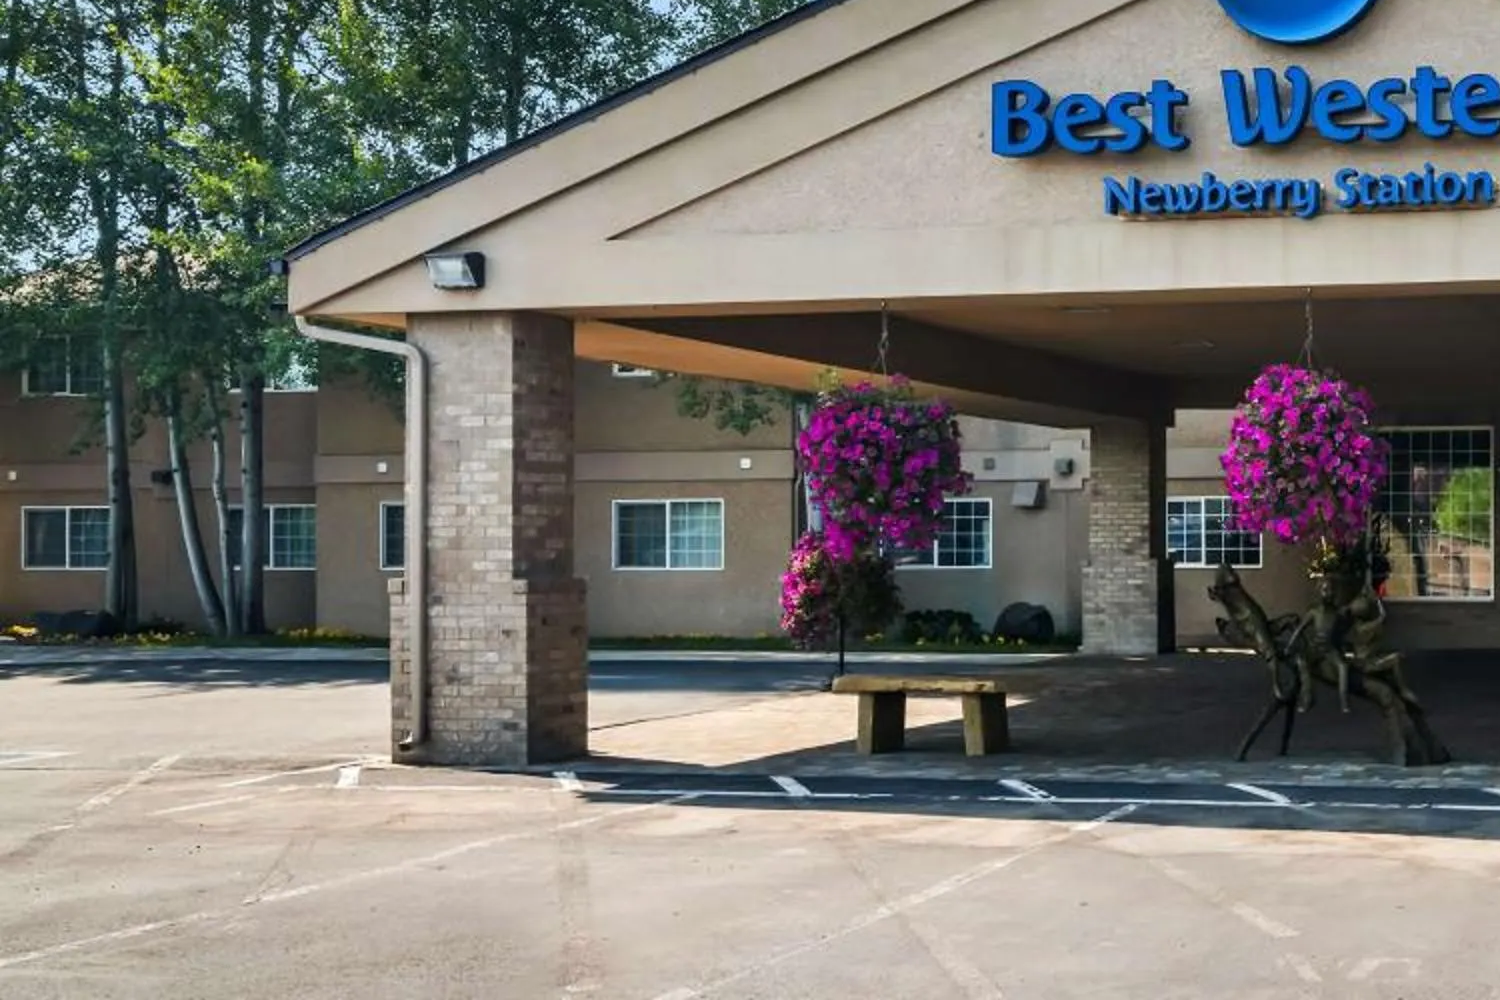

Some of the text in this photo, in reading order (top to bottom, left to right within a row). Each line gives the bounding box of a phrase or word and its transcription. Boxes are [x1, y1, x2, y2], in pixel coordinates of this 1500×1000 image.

[992, 79, 1190, 157] Best
[1103, 163, 1496, 218] Newberry Station
